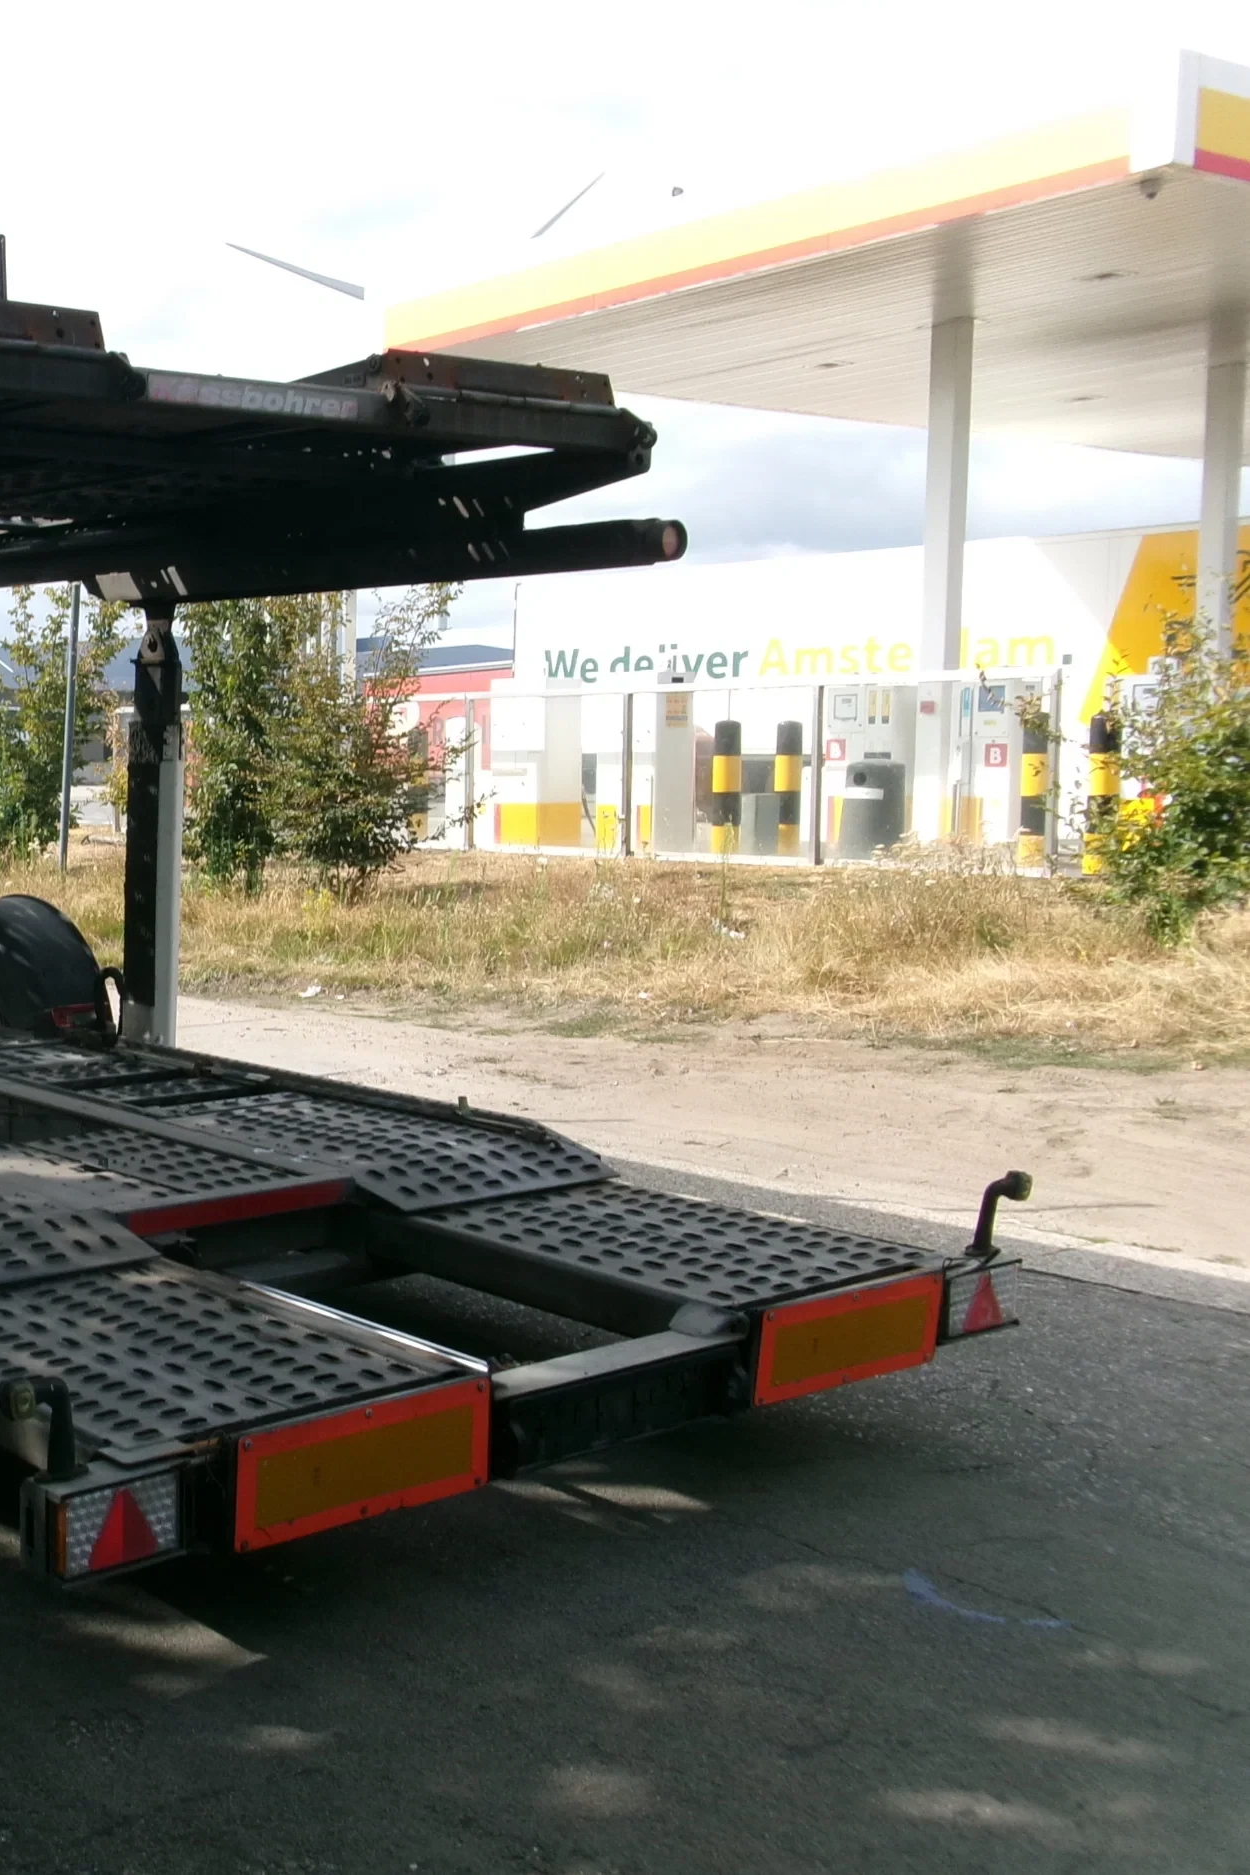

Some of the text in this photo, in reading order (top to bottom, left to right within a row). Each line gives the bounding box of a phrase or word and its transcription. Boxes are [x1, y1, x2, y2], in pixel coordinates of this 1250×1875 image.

[545, 627, 1071, 683] We deiver Amsteam.
